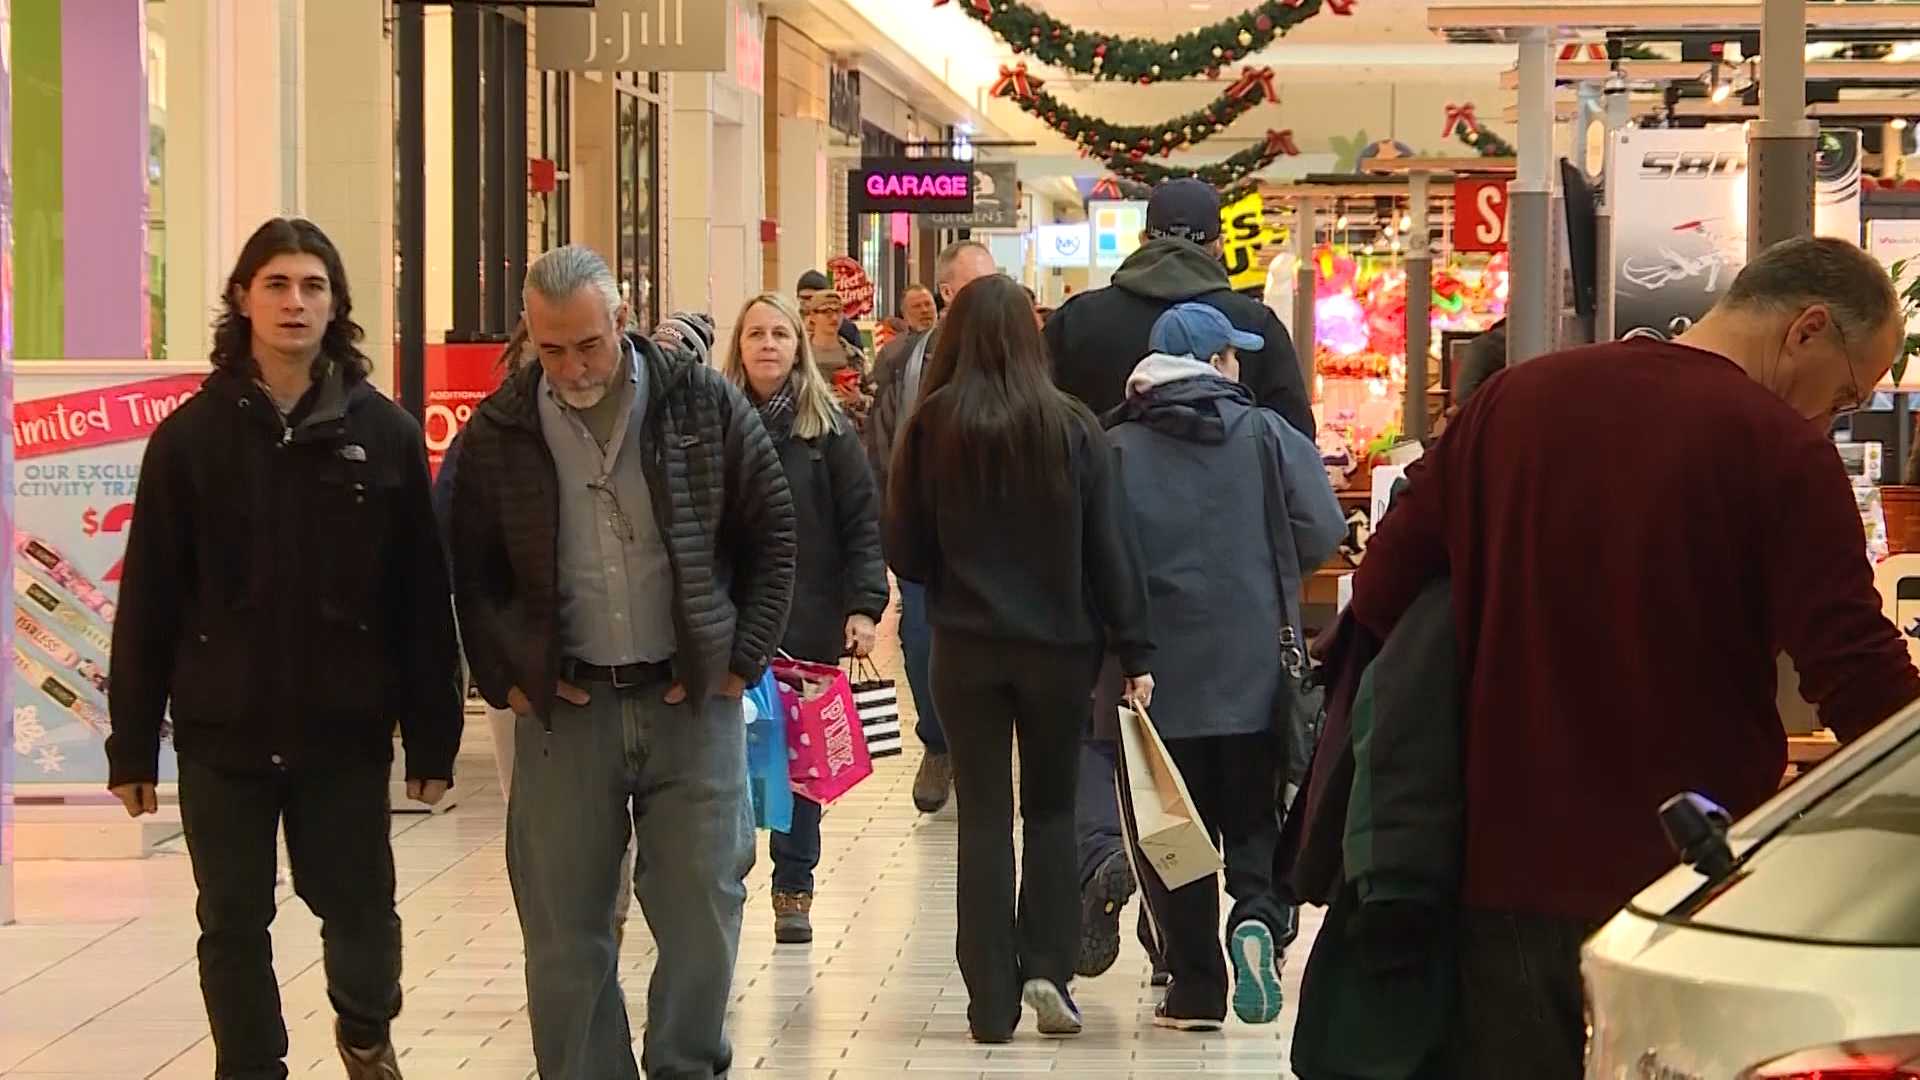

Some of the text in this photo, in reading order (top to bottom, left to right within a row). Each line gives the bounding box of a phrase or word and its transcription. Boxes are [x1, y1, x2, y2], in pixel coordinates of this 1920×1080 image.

[866, 175, 967, 196] GARAGE
[24, 464, 70, 481] OUR
[13, 480, 95, 497] CTIVITY
[820, 693, 855, 778] PINK
